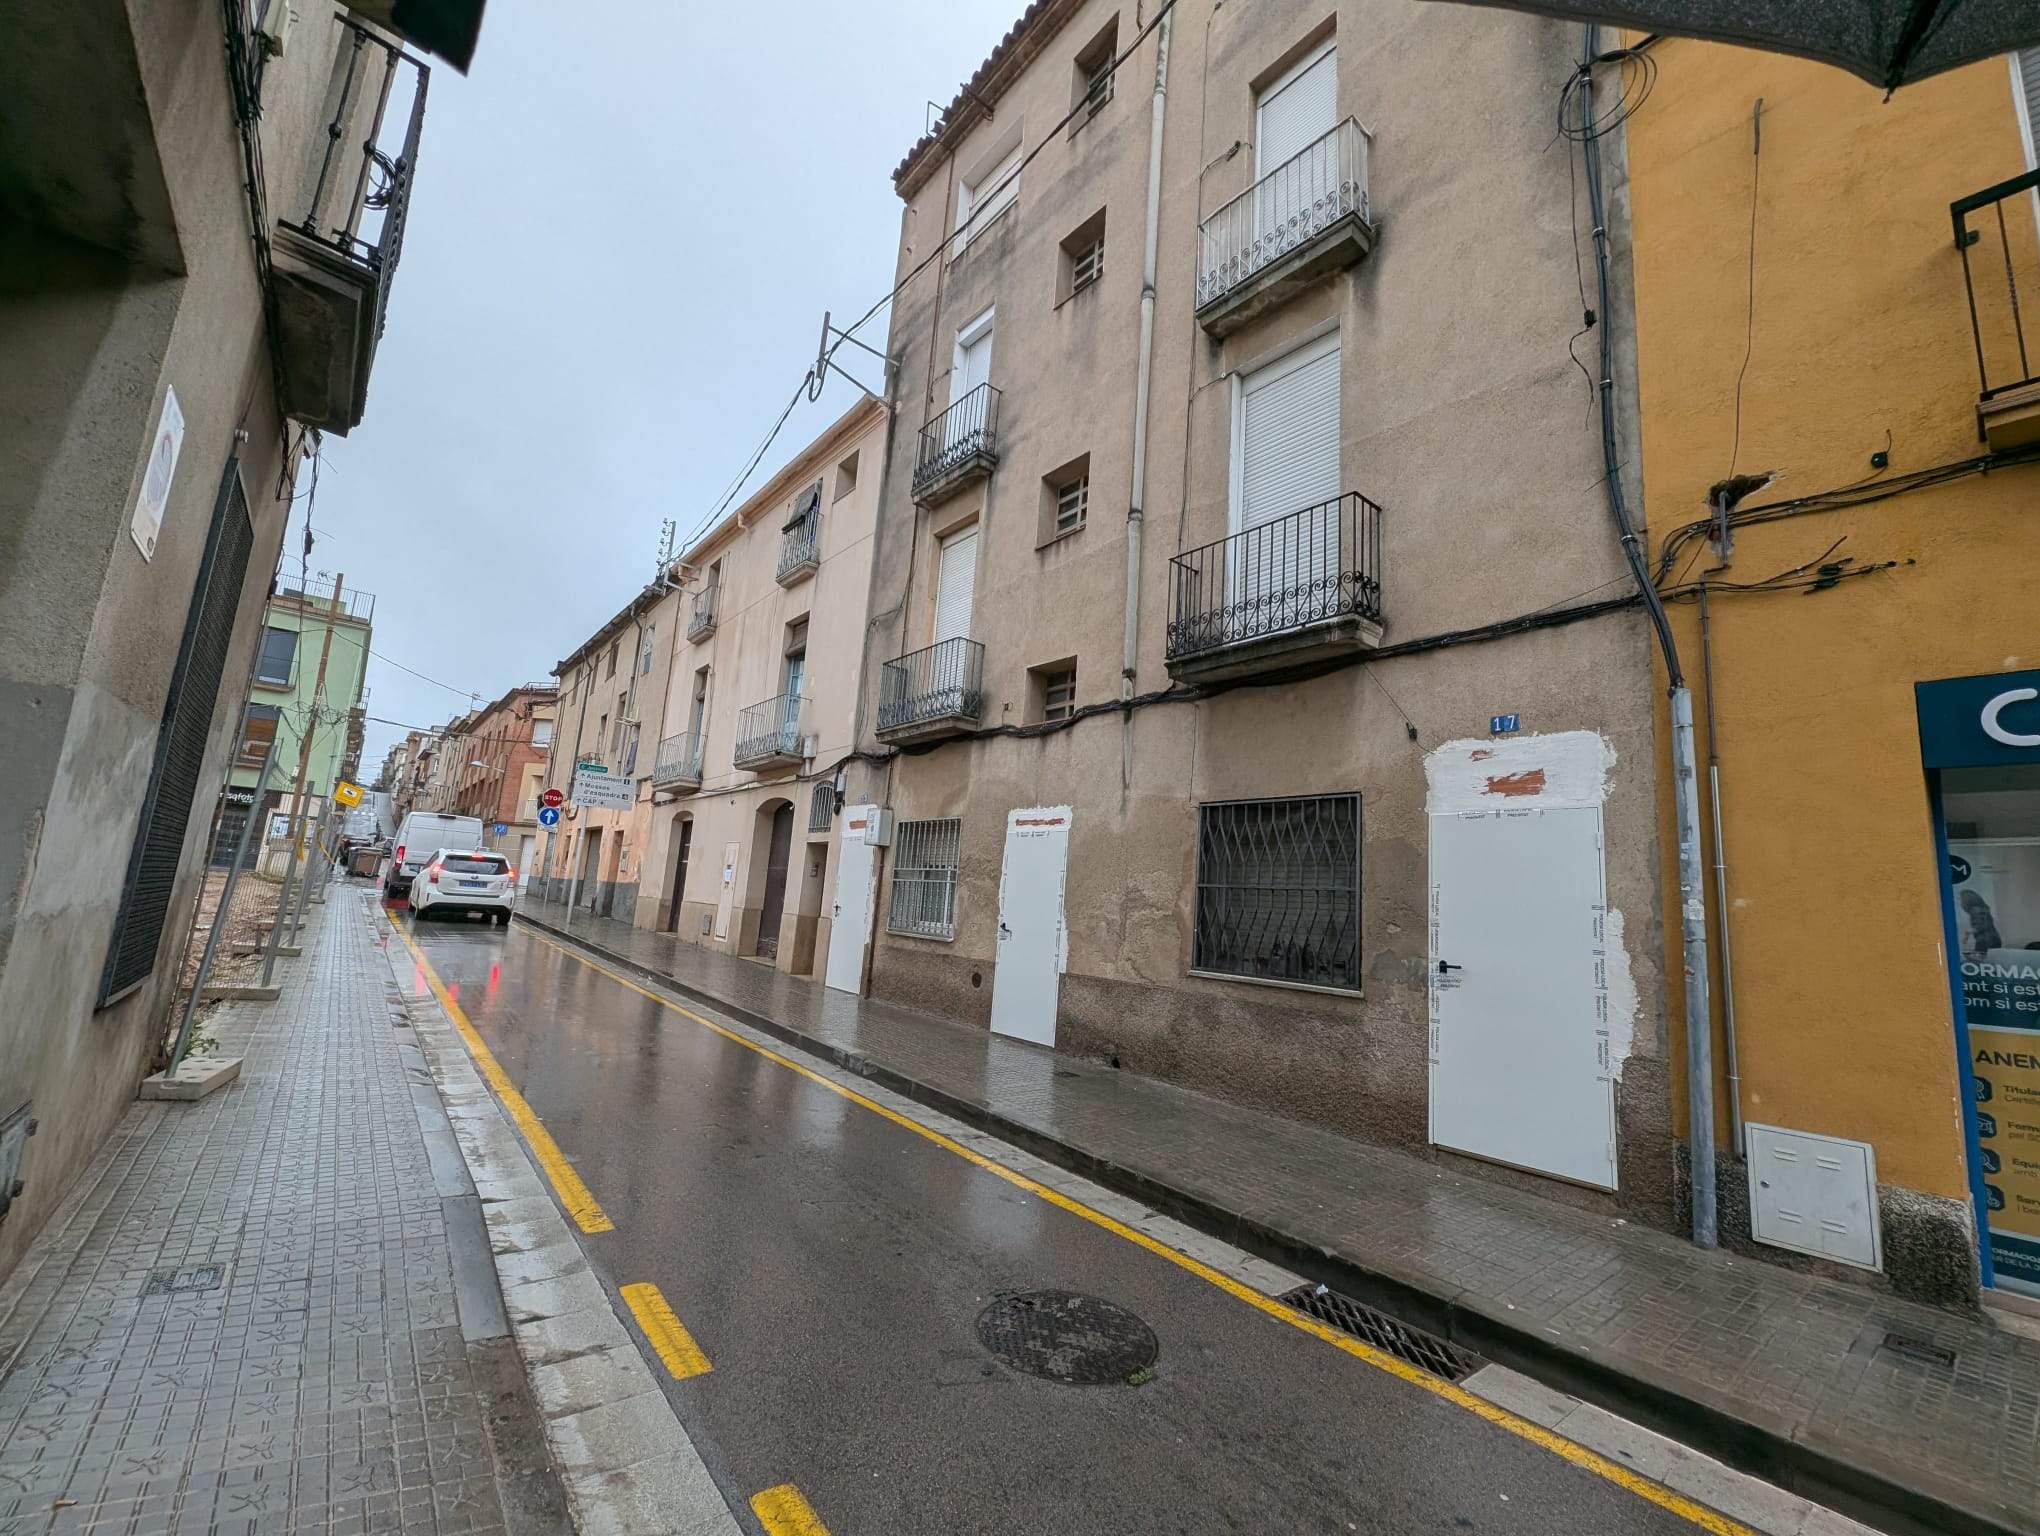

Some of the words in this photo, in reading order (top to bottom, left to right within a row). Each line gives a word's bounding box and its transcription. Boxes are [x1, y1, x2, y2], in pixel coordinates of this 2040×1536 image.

[1493, 715, 1515, 731] 17
[587, 773, 622, 785] Ajuntament
[585, 782, 610, 790] Mossos
[1961, 963, 2040, 980] ORMA
[1994, 983, 2008, 993] si
[1996, 998, 2010, 1009] si
